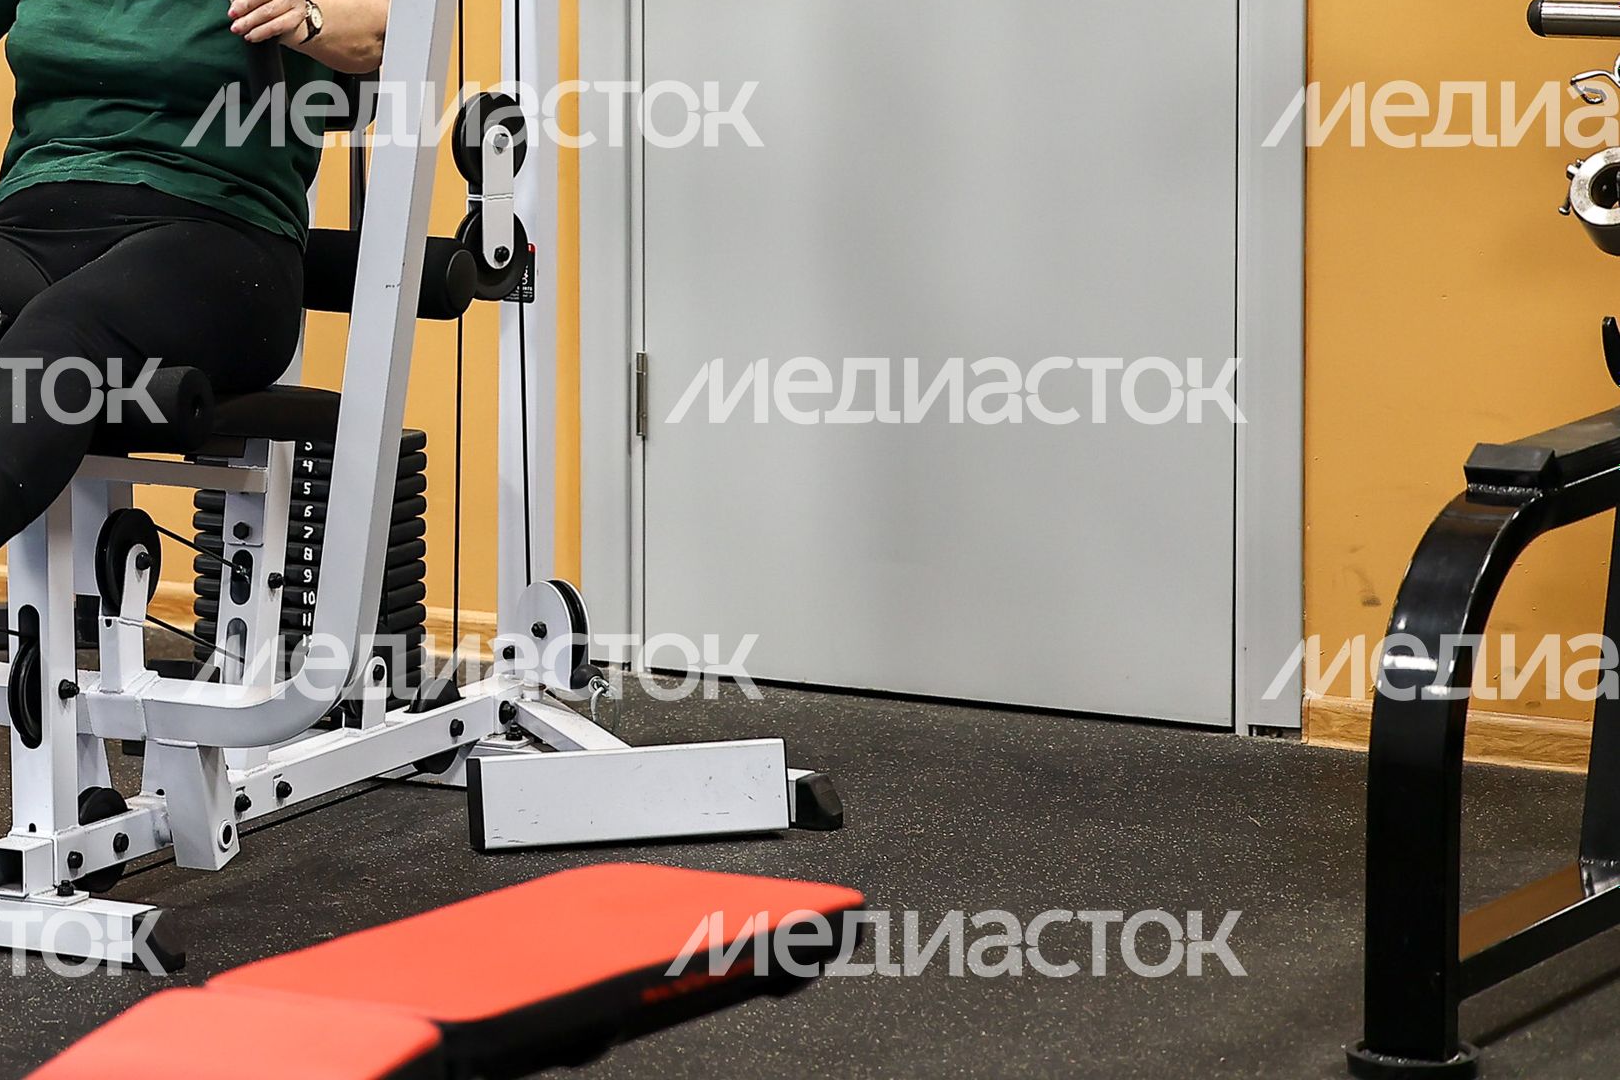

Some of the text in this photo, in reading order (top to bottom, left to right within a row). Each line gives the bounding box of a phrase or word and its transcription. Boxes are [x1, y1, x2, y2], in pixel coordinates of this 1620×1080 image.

[302, 460, 313, 472] 4
[303, 482, 312, 494] 5
[304, 506, 313, 517] 6
[303, 526, 314, 538] 7
[304, 547, 312, 561] 8
[303, 569, 312, 583] 9
[303, 591, 316, 605] 10
[303, 612, 312, 626] 11
